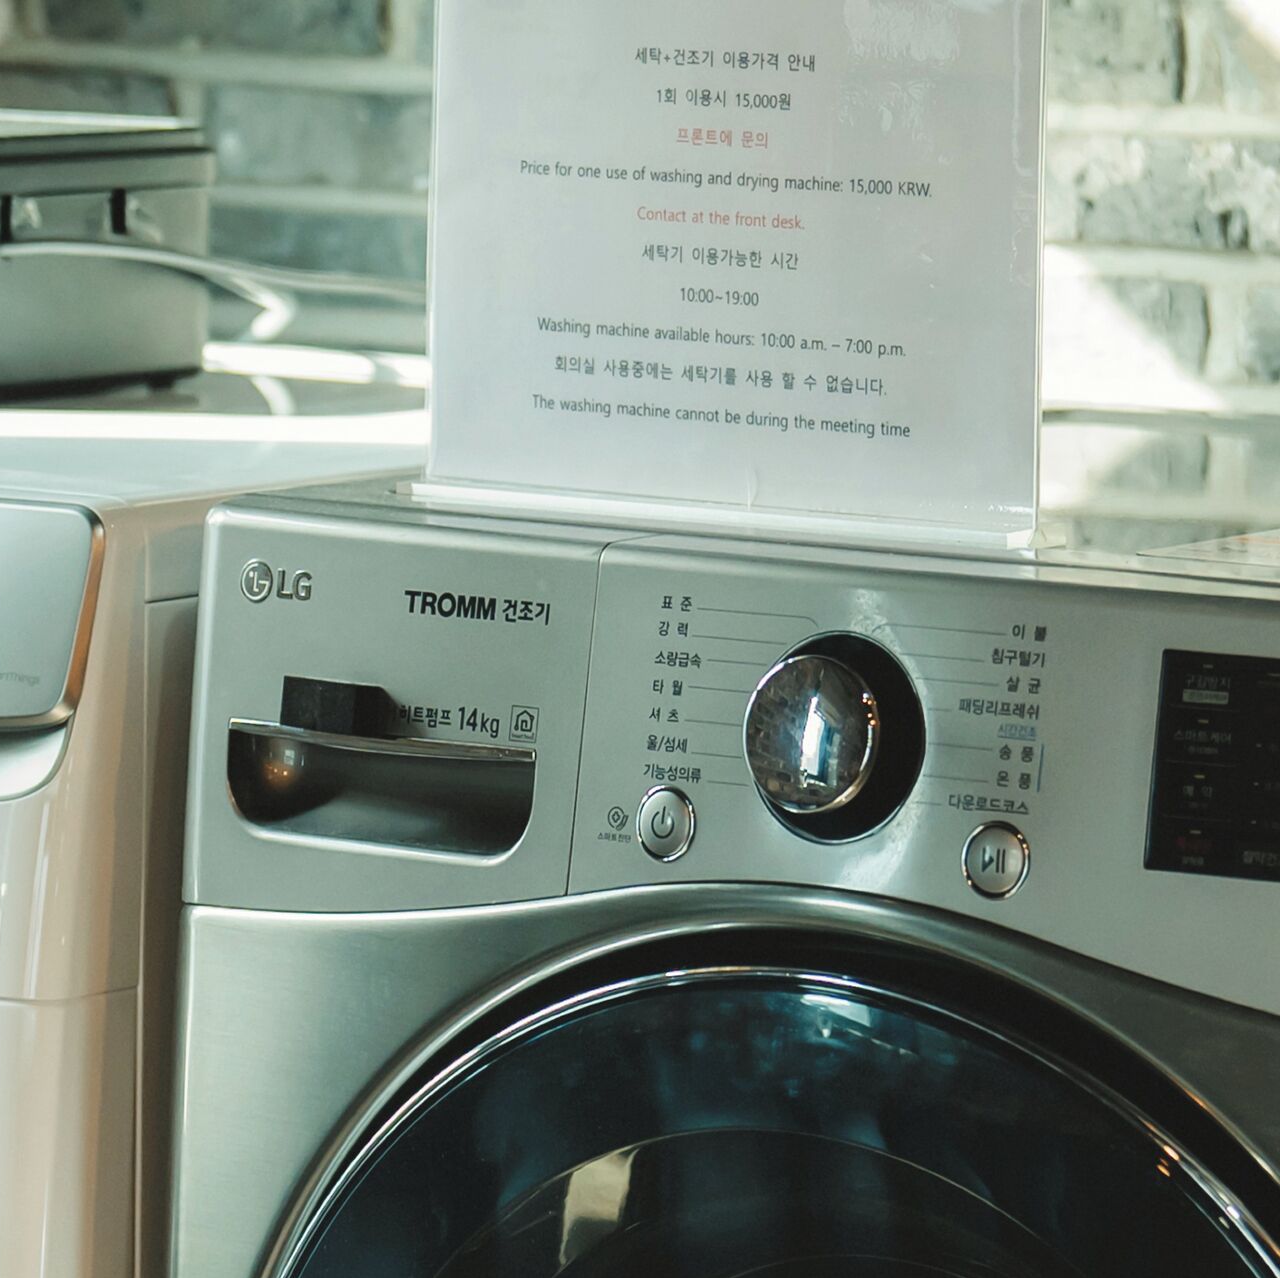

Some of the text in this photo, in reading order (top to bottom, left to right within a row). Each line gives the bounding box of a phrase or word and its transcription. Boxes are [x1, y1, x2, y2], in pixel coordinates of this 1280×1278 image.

[635, 47, 815, 72] 세탁+건조기 이용가격 안내
[657, 88, 791, 111] 1회 이용시 15,000원
[677, 128, 768, 149] 프론트에 문의
[520, 160, 932, 197] Price for one use of washing and drying machine: 15,000 KRW.
[637, 206, 804, 229] Contact at the front desk.
[642, 244, 798, 270] 세탁기 이용가능한 시간
[680, 288, 759, 306] 10:00~19:00
[537, 317, 590, 338] Washing
[596, 322, 649, 338] machine
[654, 326, 710, 343] available
[715, 328, 755, 346] hours:
[761, 333, 795, 349] 10:00
[800, 339, 827, 351] a.m.
[845, 338, 872, 354] 7:00
[878, 344, 906, 359] p.m.
[555, 355, 886, 396] 회의실 사용중에는 세탁기를 사용 할 수 없습니다.
[532, 394, 910, 439] The washing machine cannot be during the meeting time
[276, 568, 312, 601] LG
[404, 589, 551, 626] TROMM 건조기
[654, 651, 702, 669] 소량급속
[992, 648, 1045, 668] 침구털기
[959, 698, 1040, 720] 패딩리프레쉬
[400, 705, 500, 738] 히트펌프 14kg
[647, 734, 688, 753] 울/섬세
[643, 763, 702, 784] 기능성의류
[948, 794, 1030, 814] 다운로드코스
